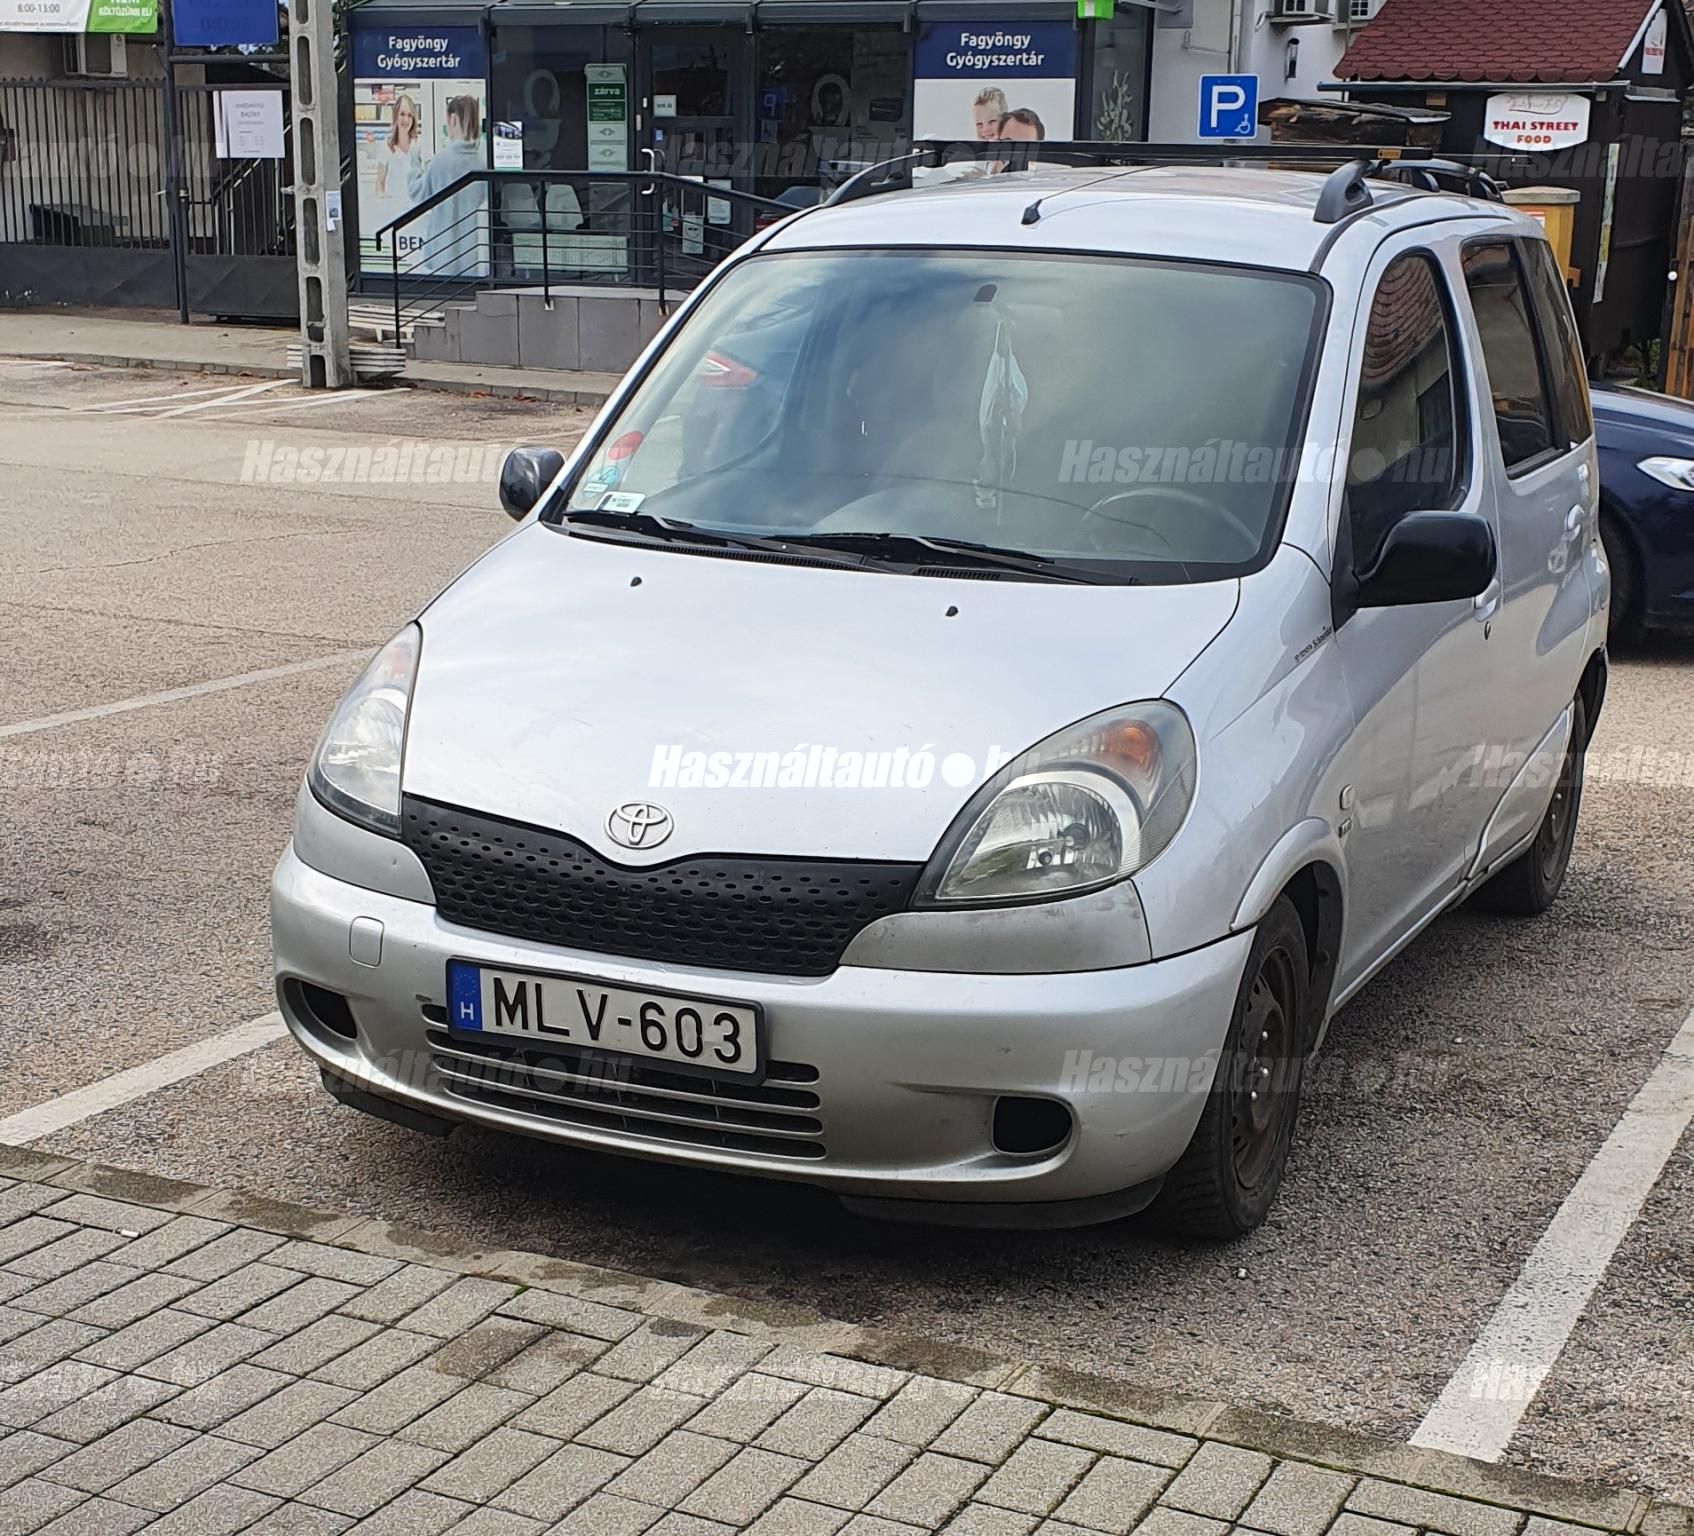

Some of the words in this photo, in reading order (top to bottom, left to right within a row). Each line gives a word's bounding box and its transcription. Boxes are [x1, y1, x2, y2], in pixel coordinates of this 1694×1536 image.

[388, 35, 449, 52] Fagyöngy
[960, 32, 1031, 49] Fagyöngy
[377, 53, 461, 70] Gyógyszertár
[946, 51, 1045, 69] Gyógyszertár
[1210, 85, 1246, 128] P
[1493, 121, 1526, 130] THAI
[1530, 121, 1578, 131] STREET
[1516, 134, 1552, 144] FOOD
[460, 1002, 474, 1021] H
[493, 976, 742, 1064] MLV-603
